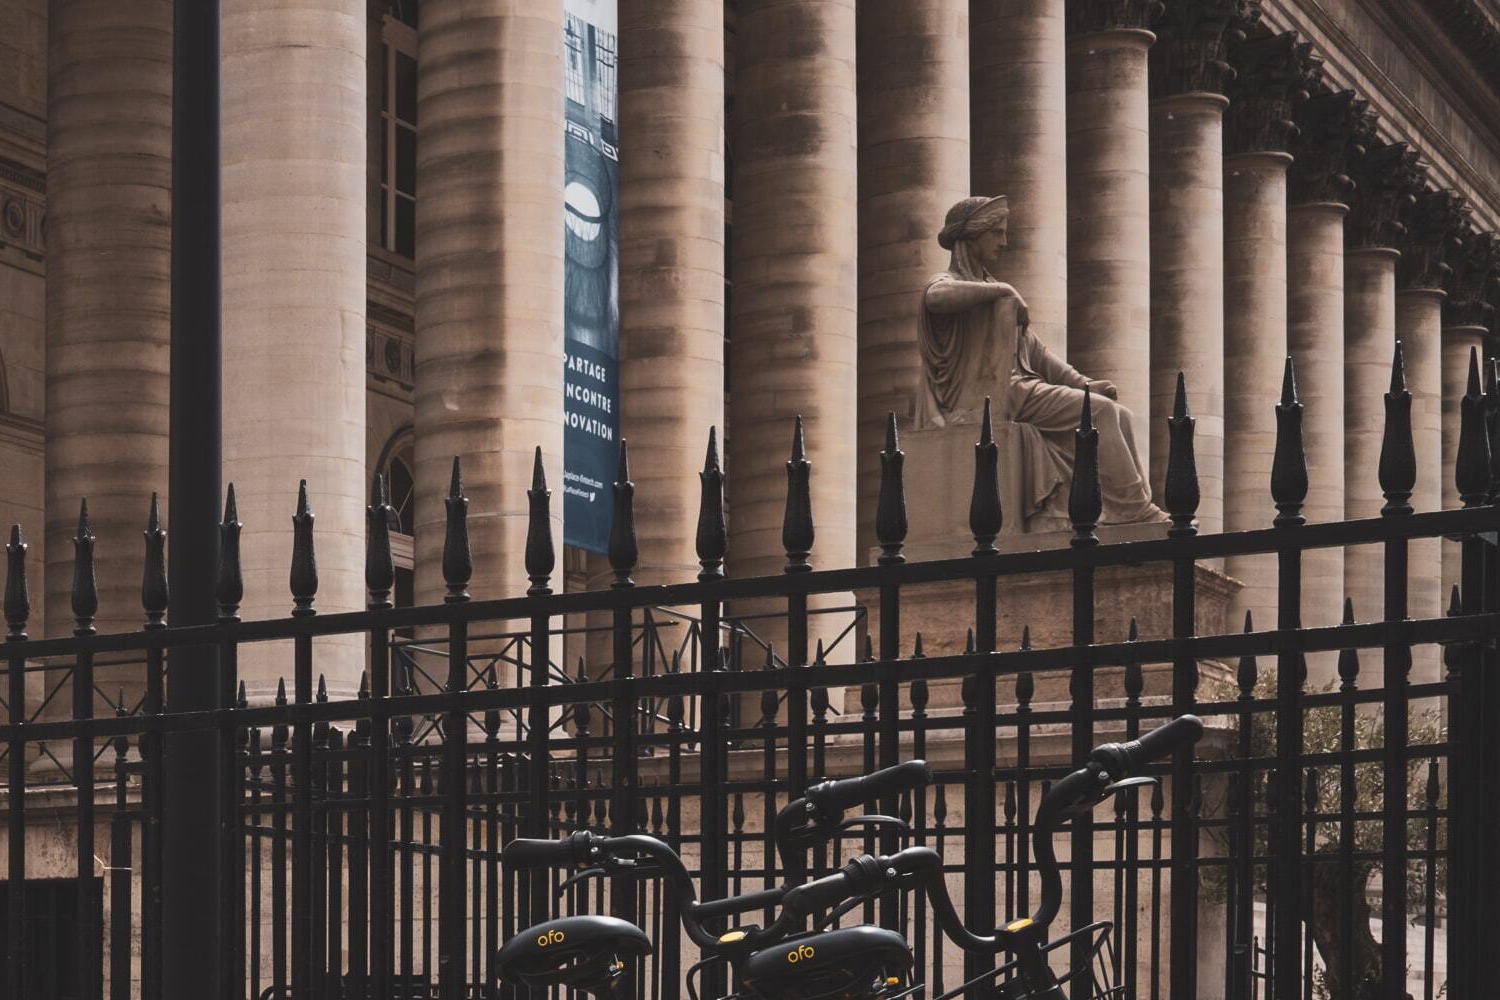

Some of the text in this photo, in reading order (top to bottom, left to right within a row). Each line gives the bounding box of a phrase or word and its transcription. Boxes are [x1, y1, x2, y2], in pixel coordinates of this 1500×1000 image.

[564, 382, 612, 414] NCONTRE
[563, 411, 613, 441] NOVATION
[537, 929, 565, 946] ofo
[787, 944, 815, 963] ofo
